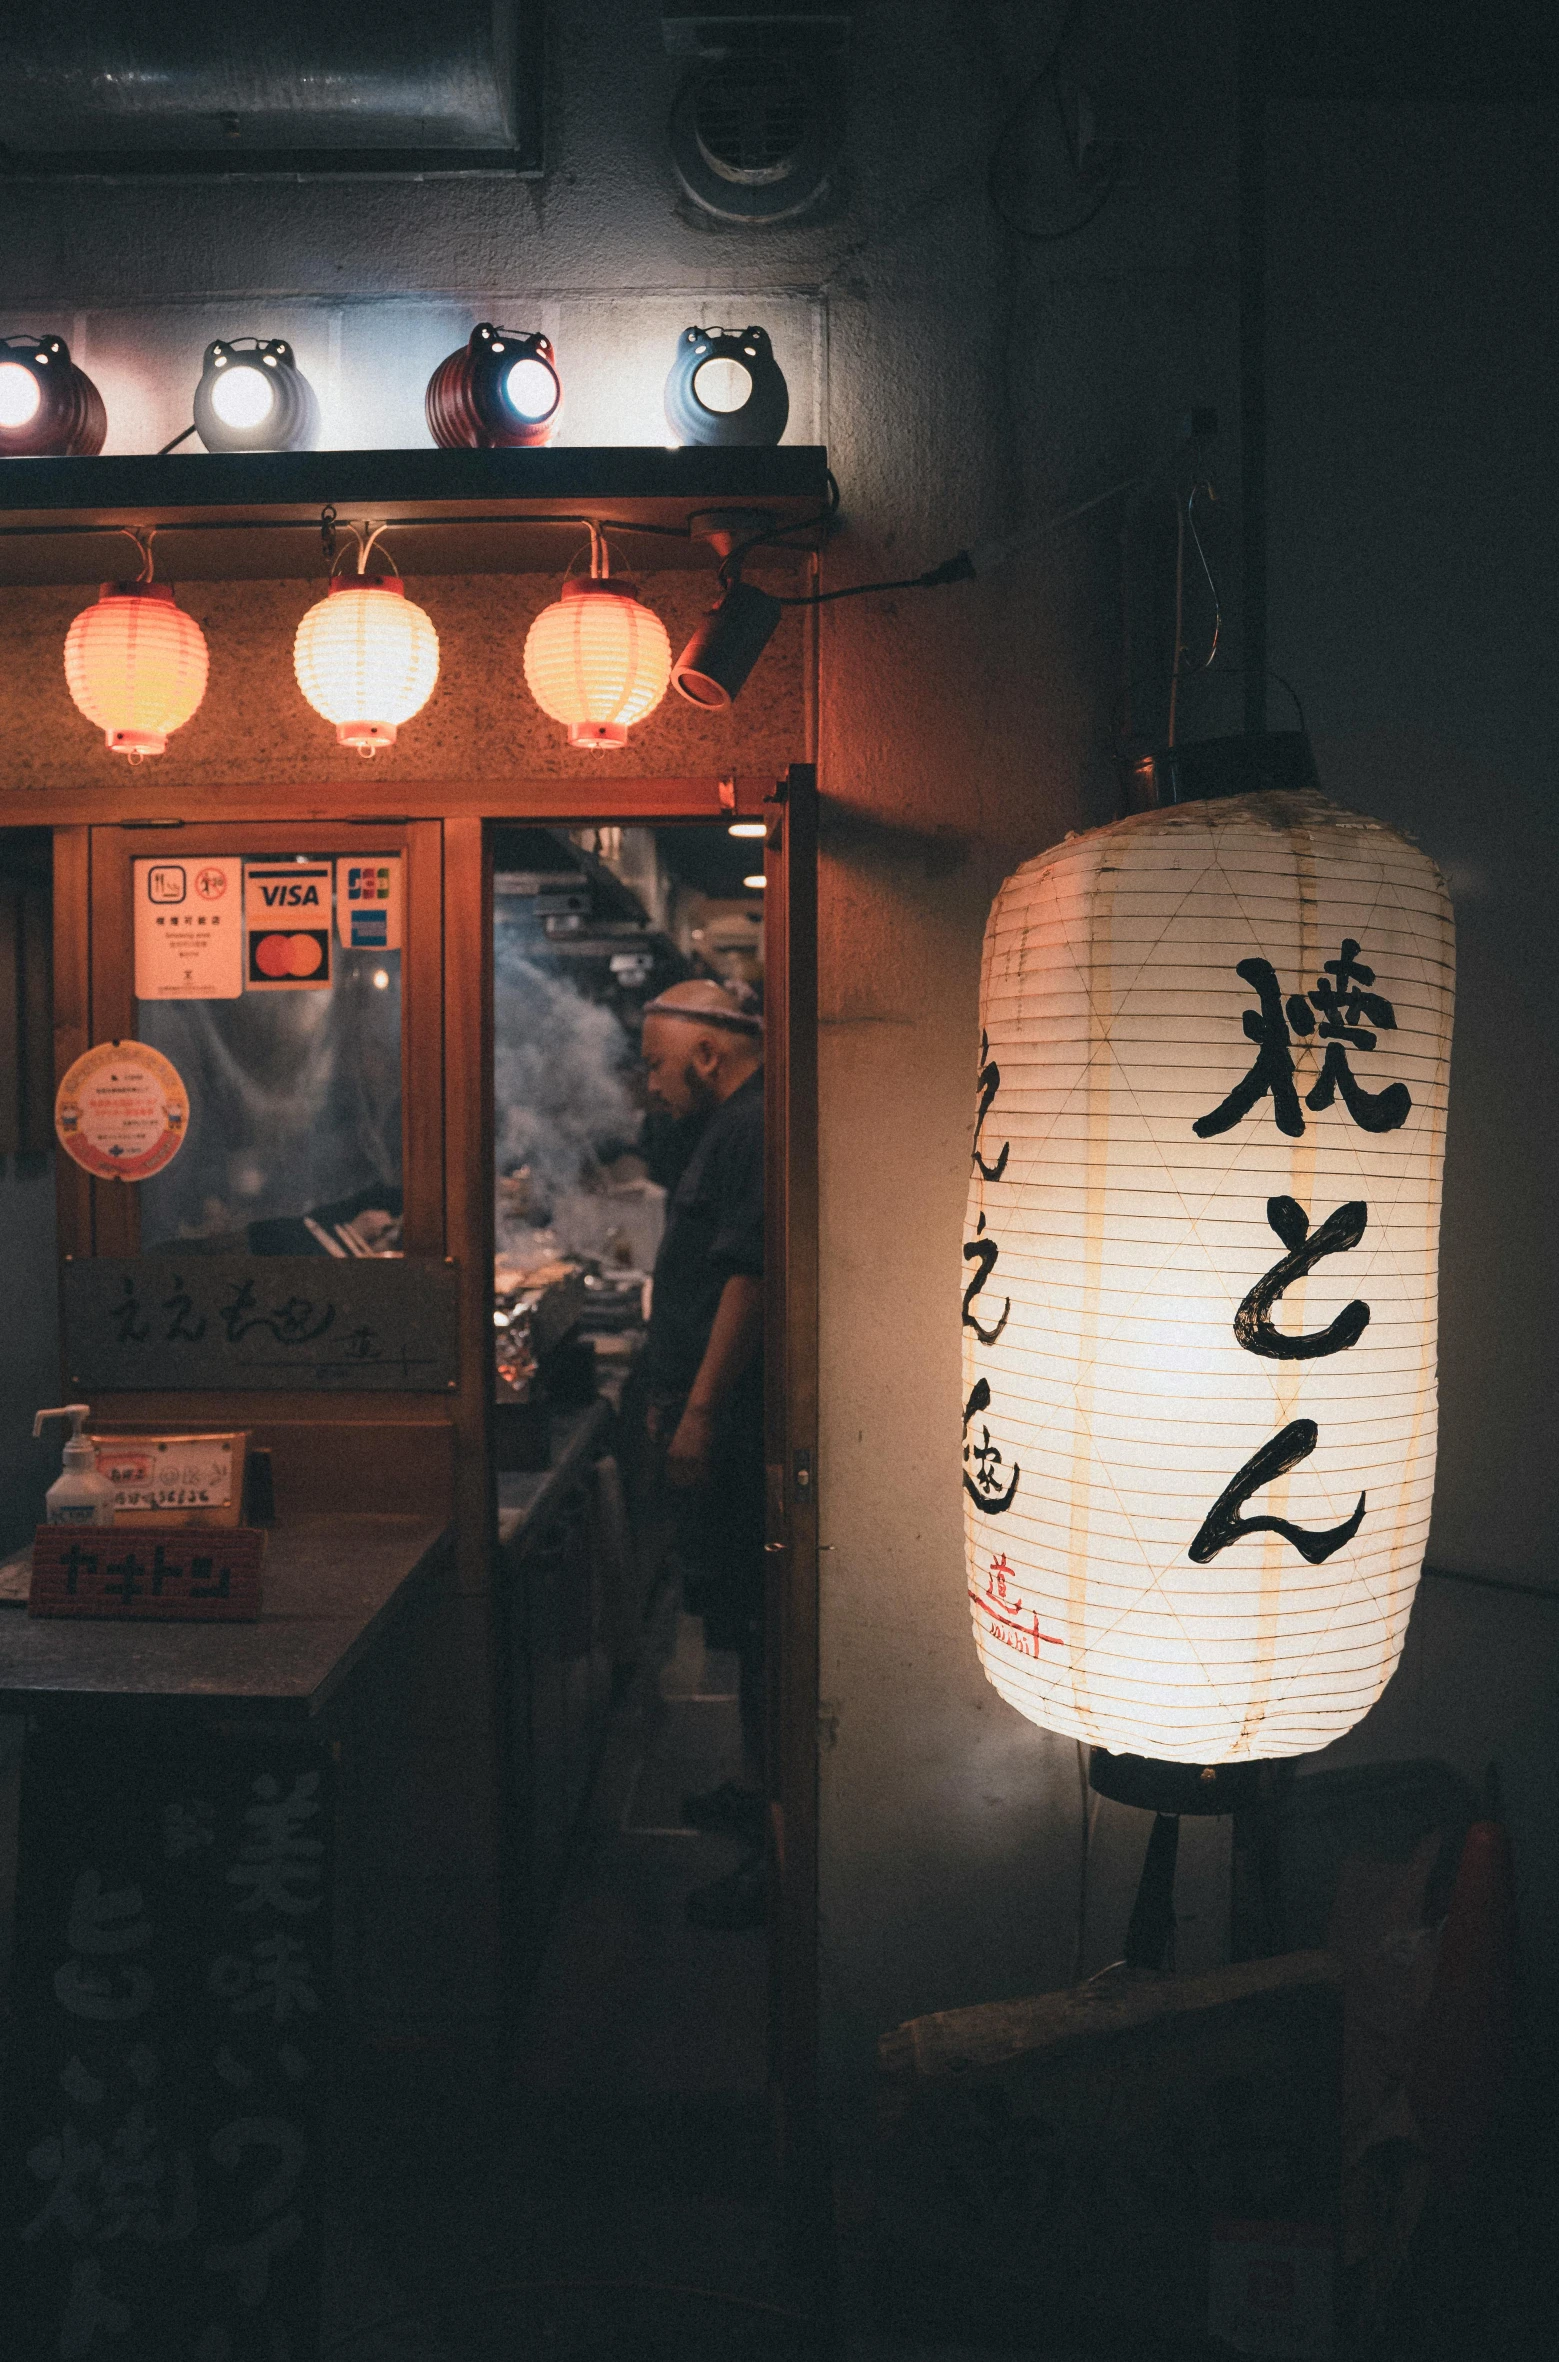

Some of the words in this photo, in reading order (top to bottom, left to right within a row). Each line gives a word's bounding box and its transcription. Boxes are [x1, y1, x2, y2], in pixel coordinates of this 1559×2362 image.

[261, 885, 319, 905] VISA
[1188, 938, 1412, 1565] 焼とん
[60, 1545, 230, 1605] ヤキトン
